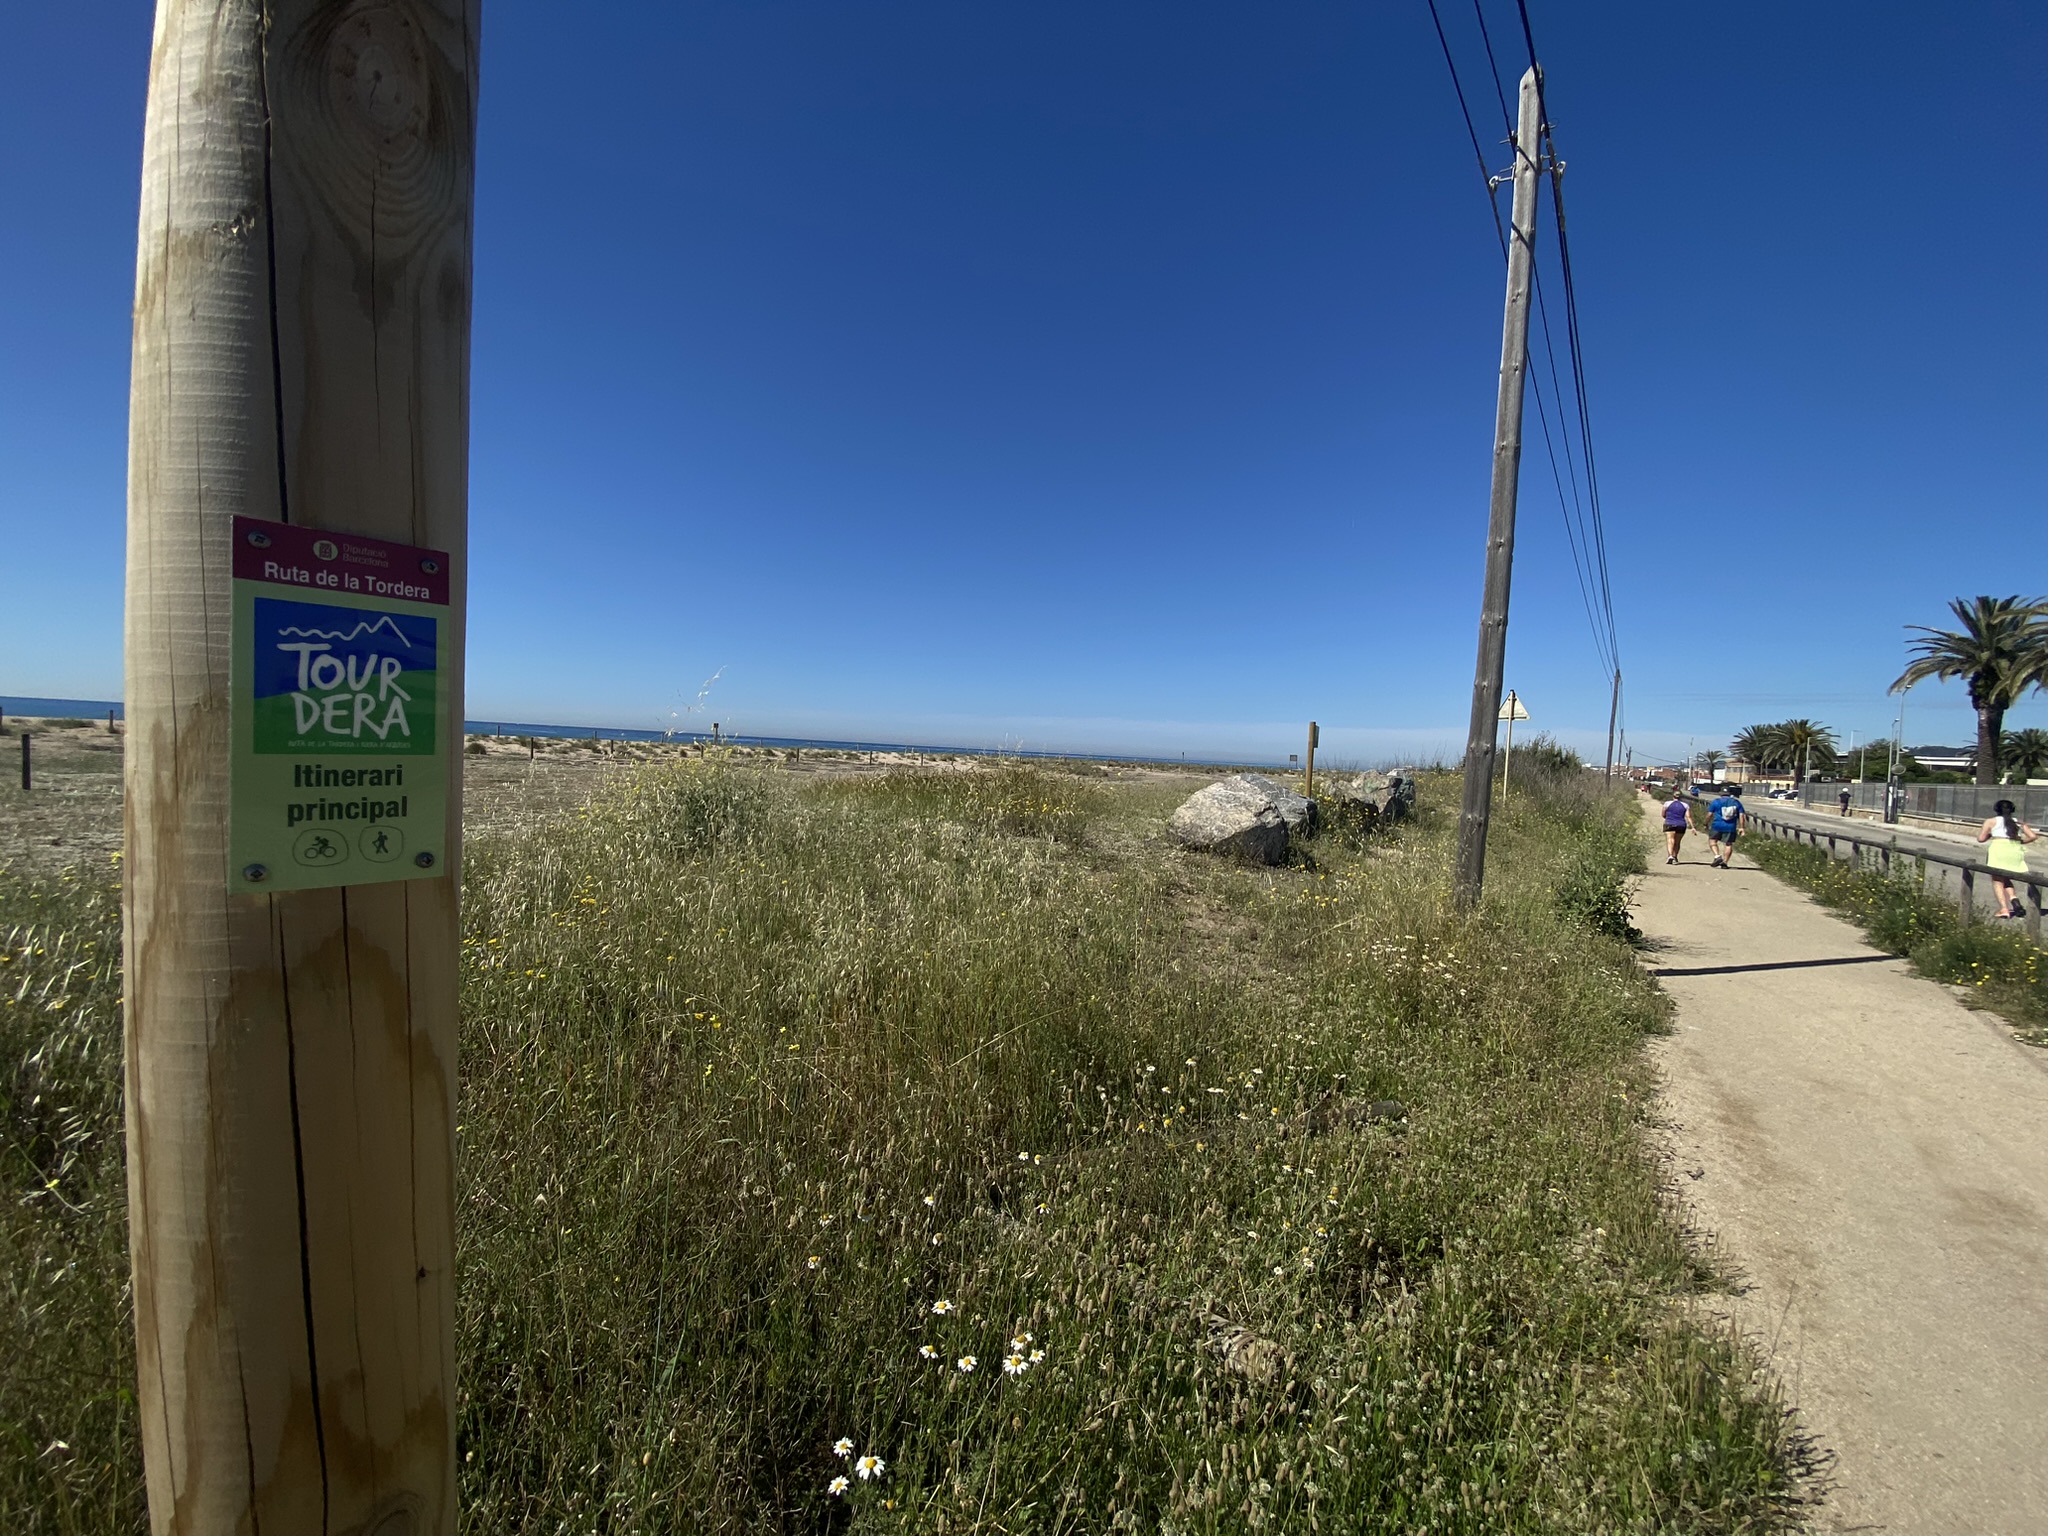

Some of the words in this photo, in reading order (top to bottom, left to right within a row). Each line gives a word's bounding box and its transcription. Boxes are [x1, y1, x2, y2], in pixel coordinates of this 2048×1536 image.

[264, 561, 310, 583] Ruta
[316, 569, 339, 587] de
[344, 572, 360, 590] la
[365, 576, 430, 599] Tordera
[276, 642, 412, 702] TOUR
[290, 691, 411, 740] DERA
[293, 763, 403, 788] Itinerari
[287, 795, 408, 827] principal
